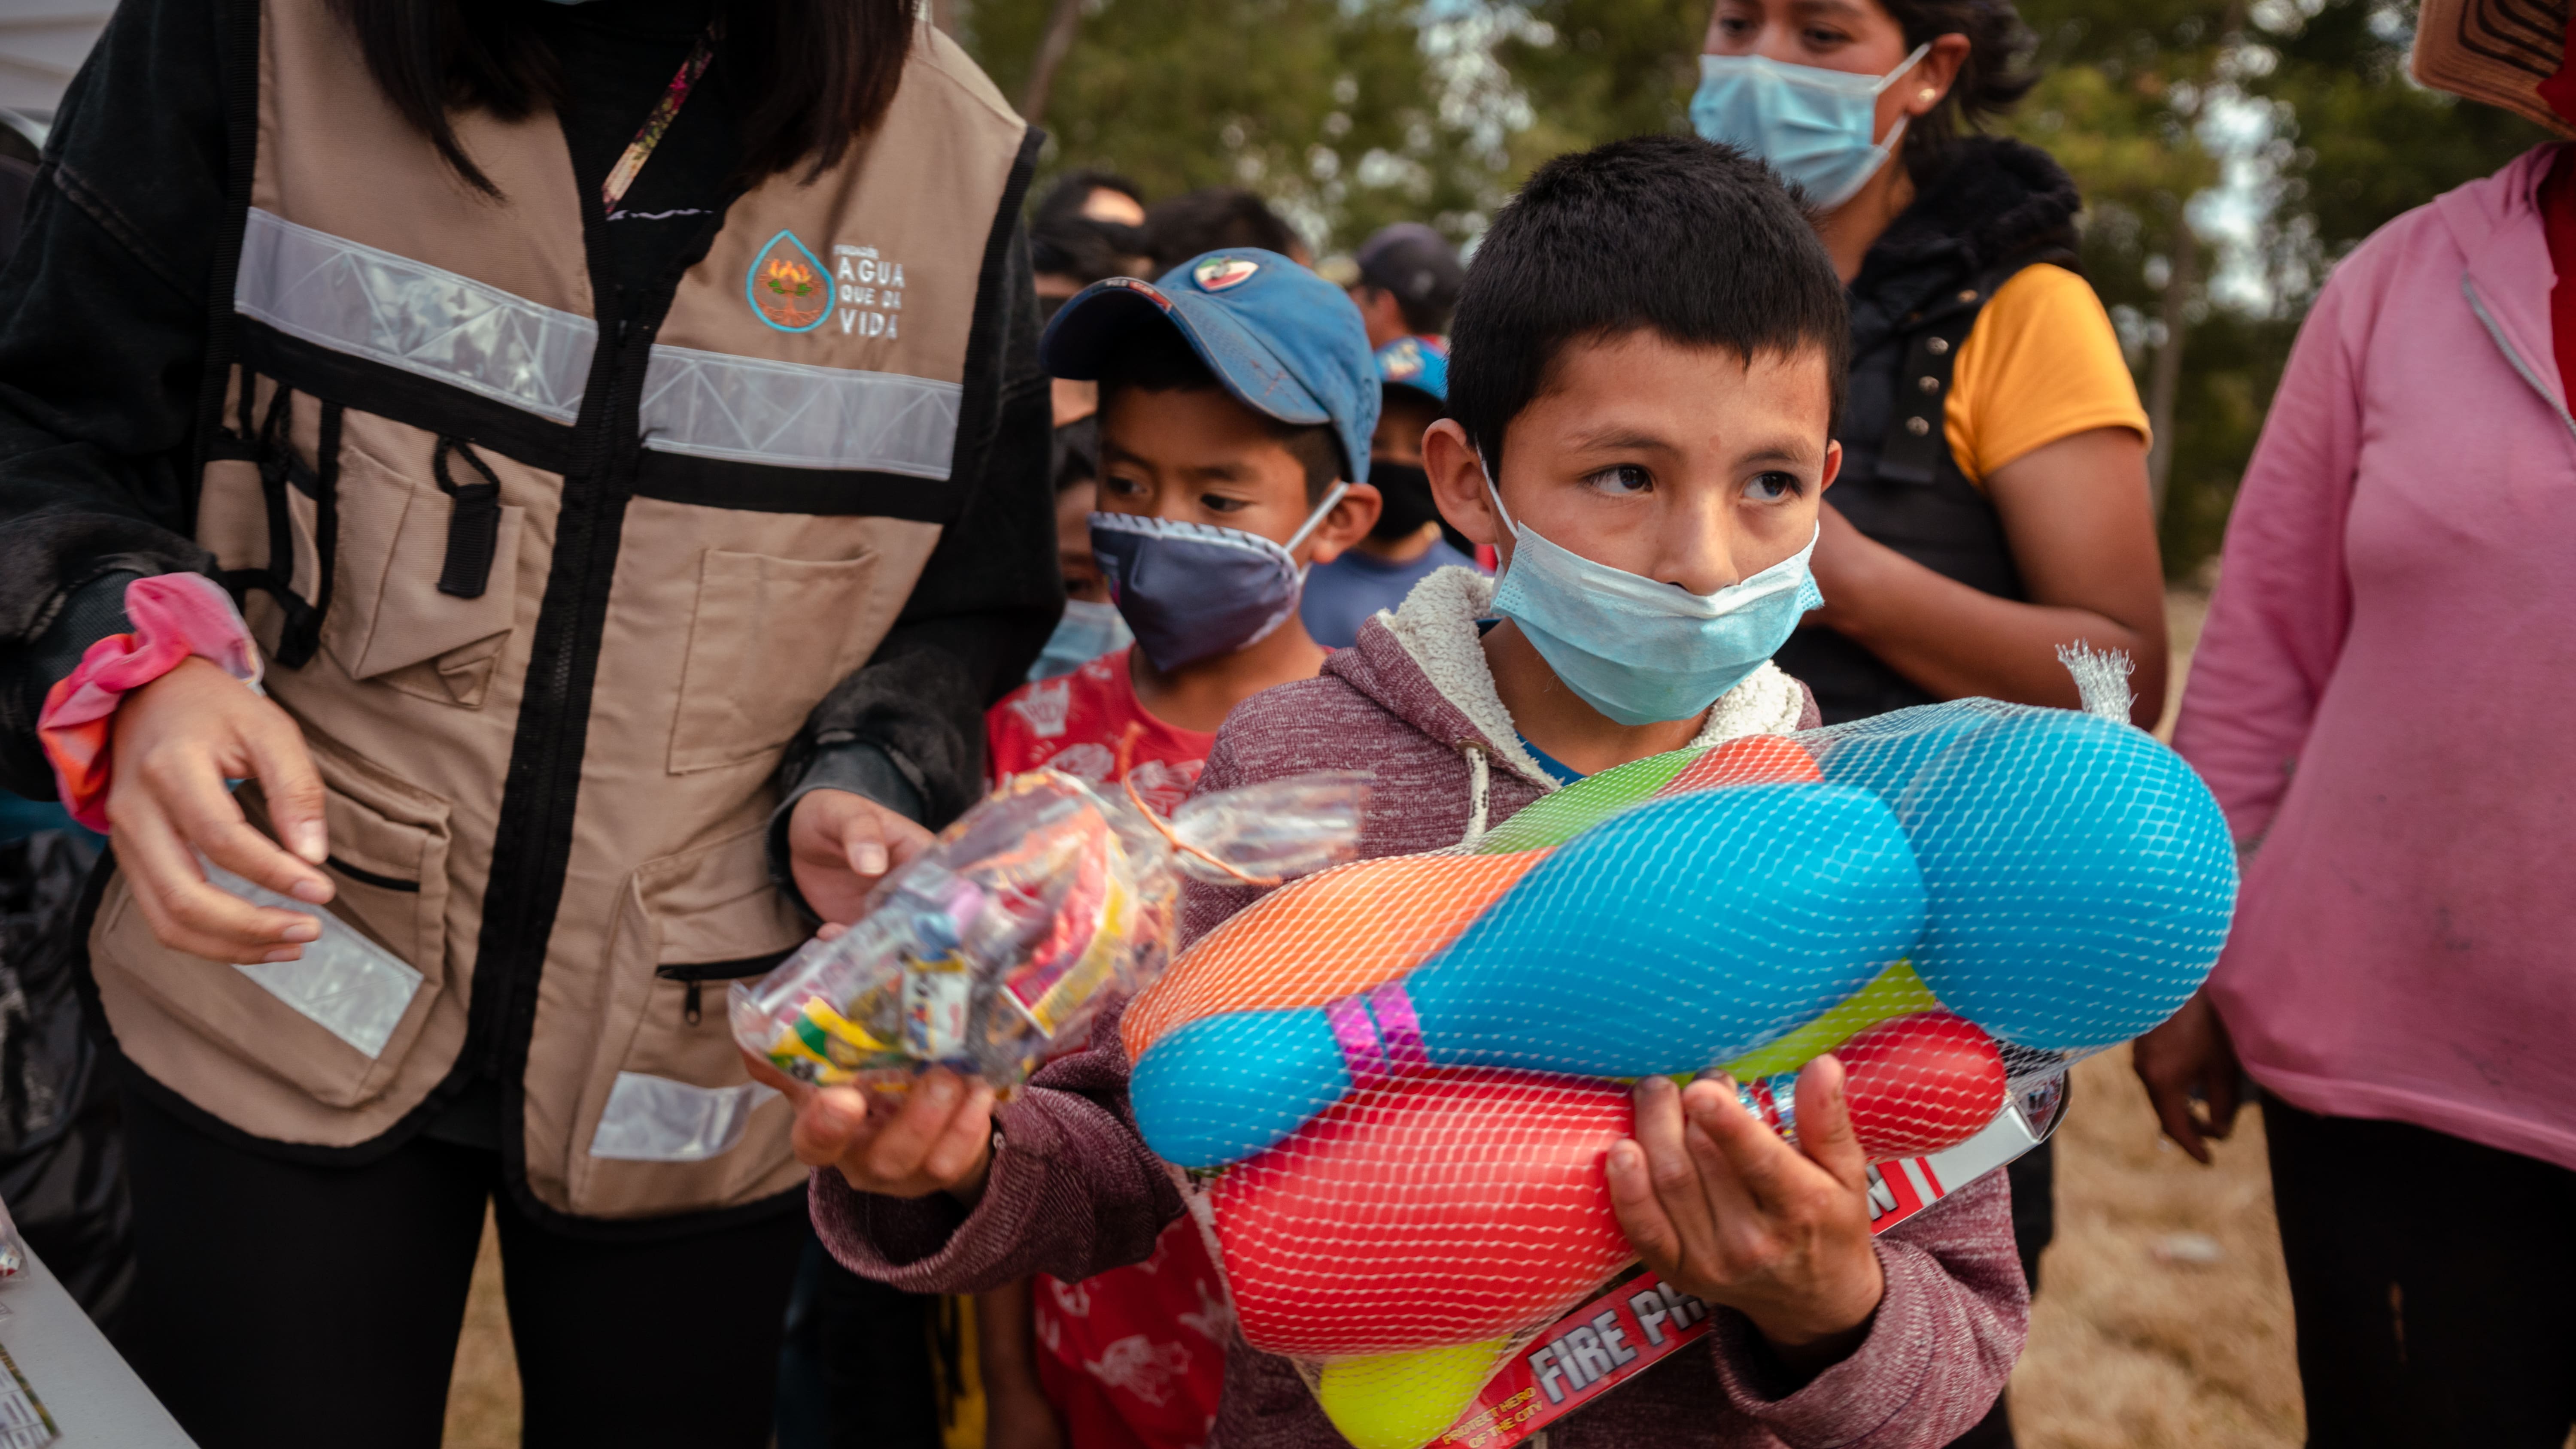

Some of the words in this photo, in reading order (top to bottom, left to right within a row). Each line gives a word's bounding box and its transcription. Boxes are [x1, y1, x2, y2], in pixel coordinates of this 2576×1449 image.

[837, 256, 905, 288] AGUA
[840, 284, 876, 306] QUE
[881, 290, 902, 310] DA
[838, 307, 898, 340] VIDA
[1528, 1309, 1639, 1404] FIRE
[1442, 1407, 1499, 1445] PROTECT
[1498, 1386, 1537, 1413] HERO
[1468, 1432, 1487, 1449] OF
[1487, 1417, 1517, 1437] THE
[1514, 1400, 1543, 1422] CITY
